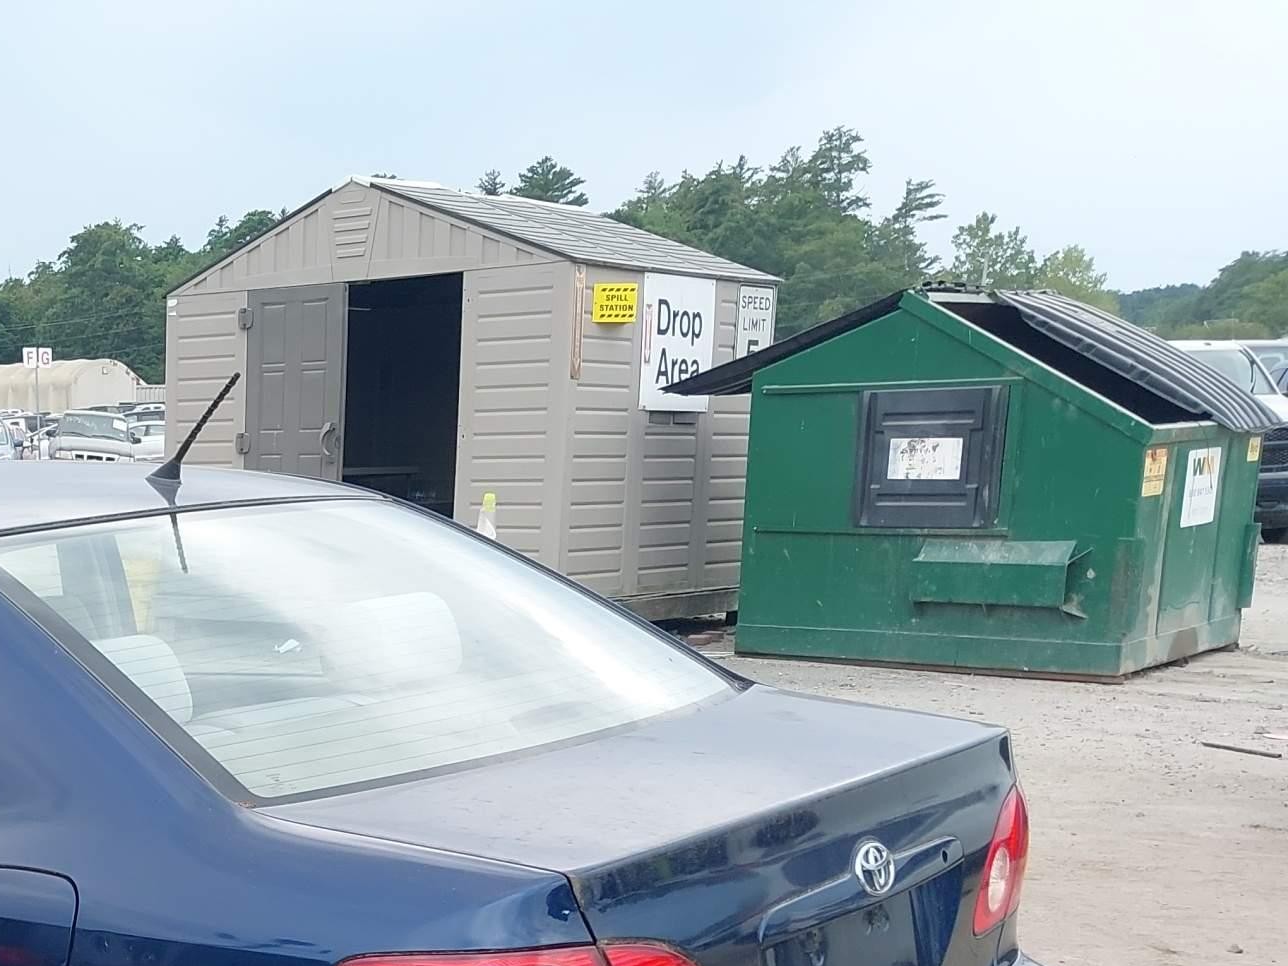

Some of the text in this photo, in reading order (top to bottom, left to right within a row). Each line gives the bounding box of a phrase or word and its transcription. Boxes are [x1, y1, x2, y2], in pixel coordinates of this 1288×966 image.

[605, 294, 629, 302] SPILL
[741, 295, 771, 311] SPEED
[599, 304, 634, 312] STATION
[656, 298, 703, 347] Drop
[742, 316, 767, 332] LIMIT
[26, 351, 34, 365] F
[41, 351, 50, 365] G
[655, 347, 700, 385] Area
